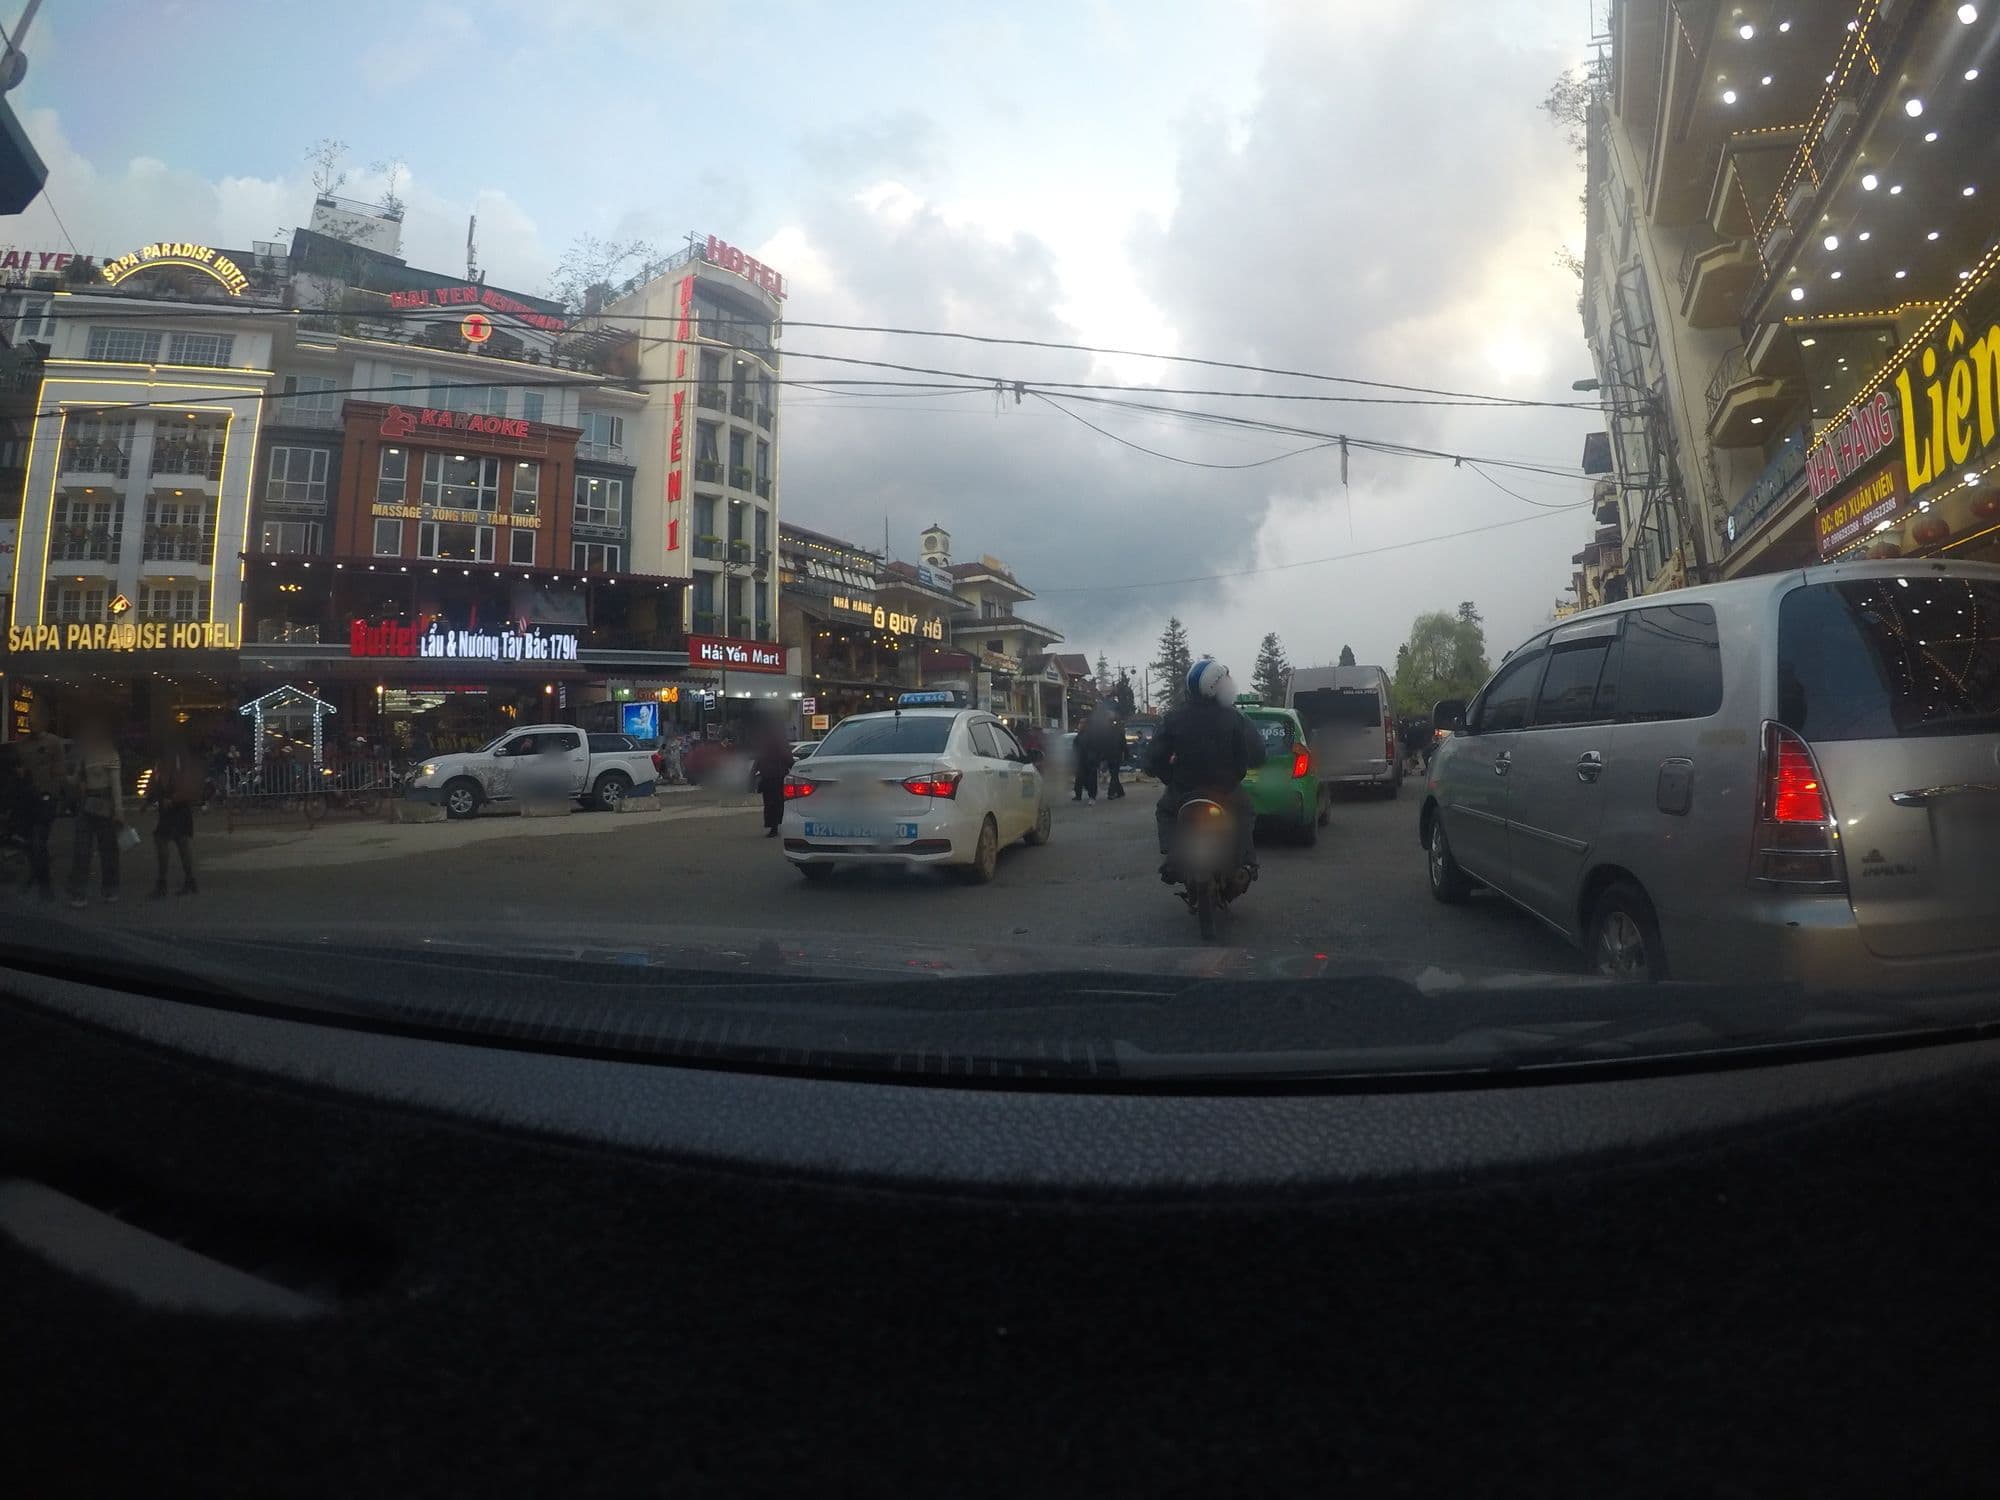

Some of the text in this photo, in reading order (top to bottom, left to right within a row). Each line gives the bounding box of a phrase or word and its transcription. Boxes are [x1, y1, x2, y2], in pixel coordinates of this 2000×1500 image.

[0, 251, 32, 271] AI
[102, 242, 250, 295] SAPA PARADISE HOTEL
[706, 234, 788, 300] HOTEL
[420, 408, 530, 438] KARAOKE
[1806, 433, 1842, 503] NHÀ
[1839, 391, 1895, 478] HÀNG
[371, 503, 422, 519] MASSAGE
[873, 606, 885, 629] Ô
[8, 622, 236, 652] SAPA PARADISE HOTEL
[447, 630, 457, 657] &
[458, 628, 499, 660] Nướng
[501, 630, 523, 661] Tây
[524, 627, 548, 659] Bắc
[550, 634, 578, 660] 179k
[701, 643, 780, 666] Hải Yến Mart
